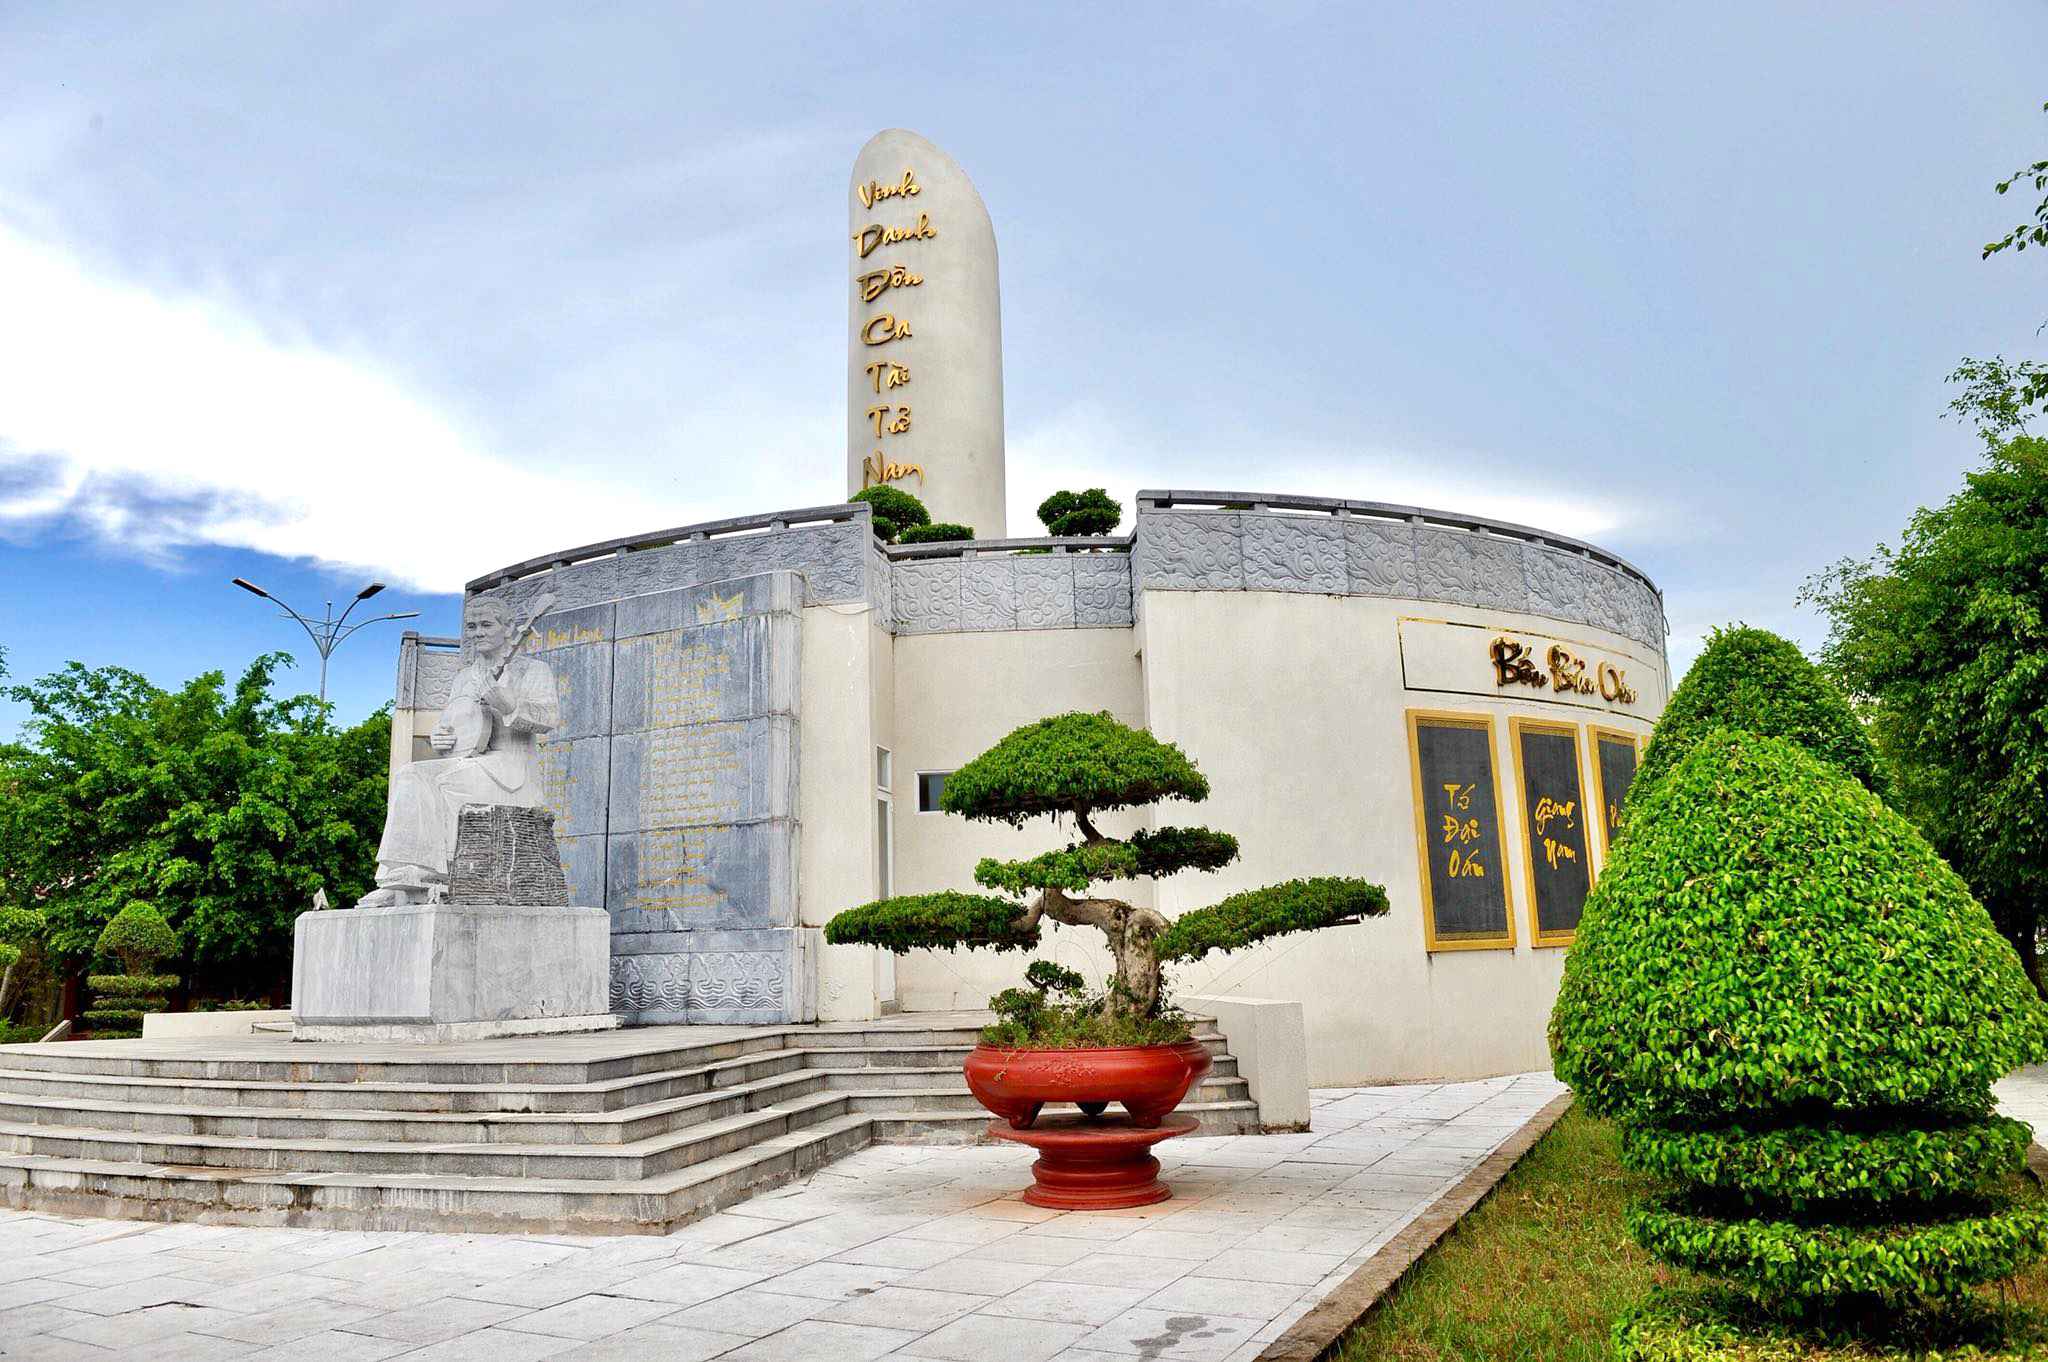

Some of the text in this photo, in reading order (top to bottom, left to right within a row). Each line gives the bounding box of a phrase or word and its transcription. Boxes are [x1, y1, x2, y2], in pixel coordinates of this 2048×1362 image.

[858, 169, 921, 210] Vinh
[852, 213, 937, 258] Danh
[861, 313, 913, 346] Ca
[864, 360, 911, 394] Tài
[863, 449, 926, 490] Nam
[1442, 814, 1481, 845] Đại
